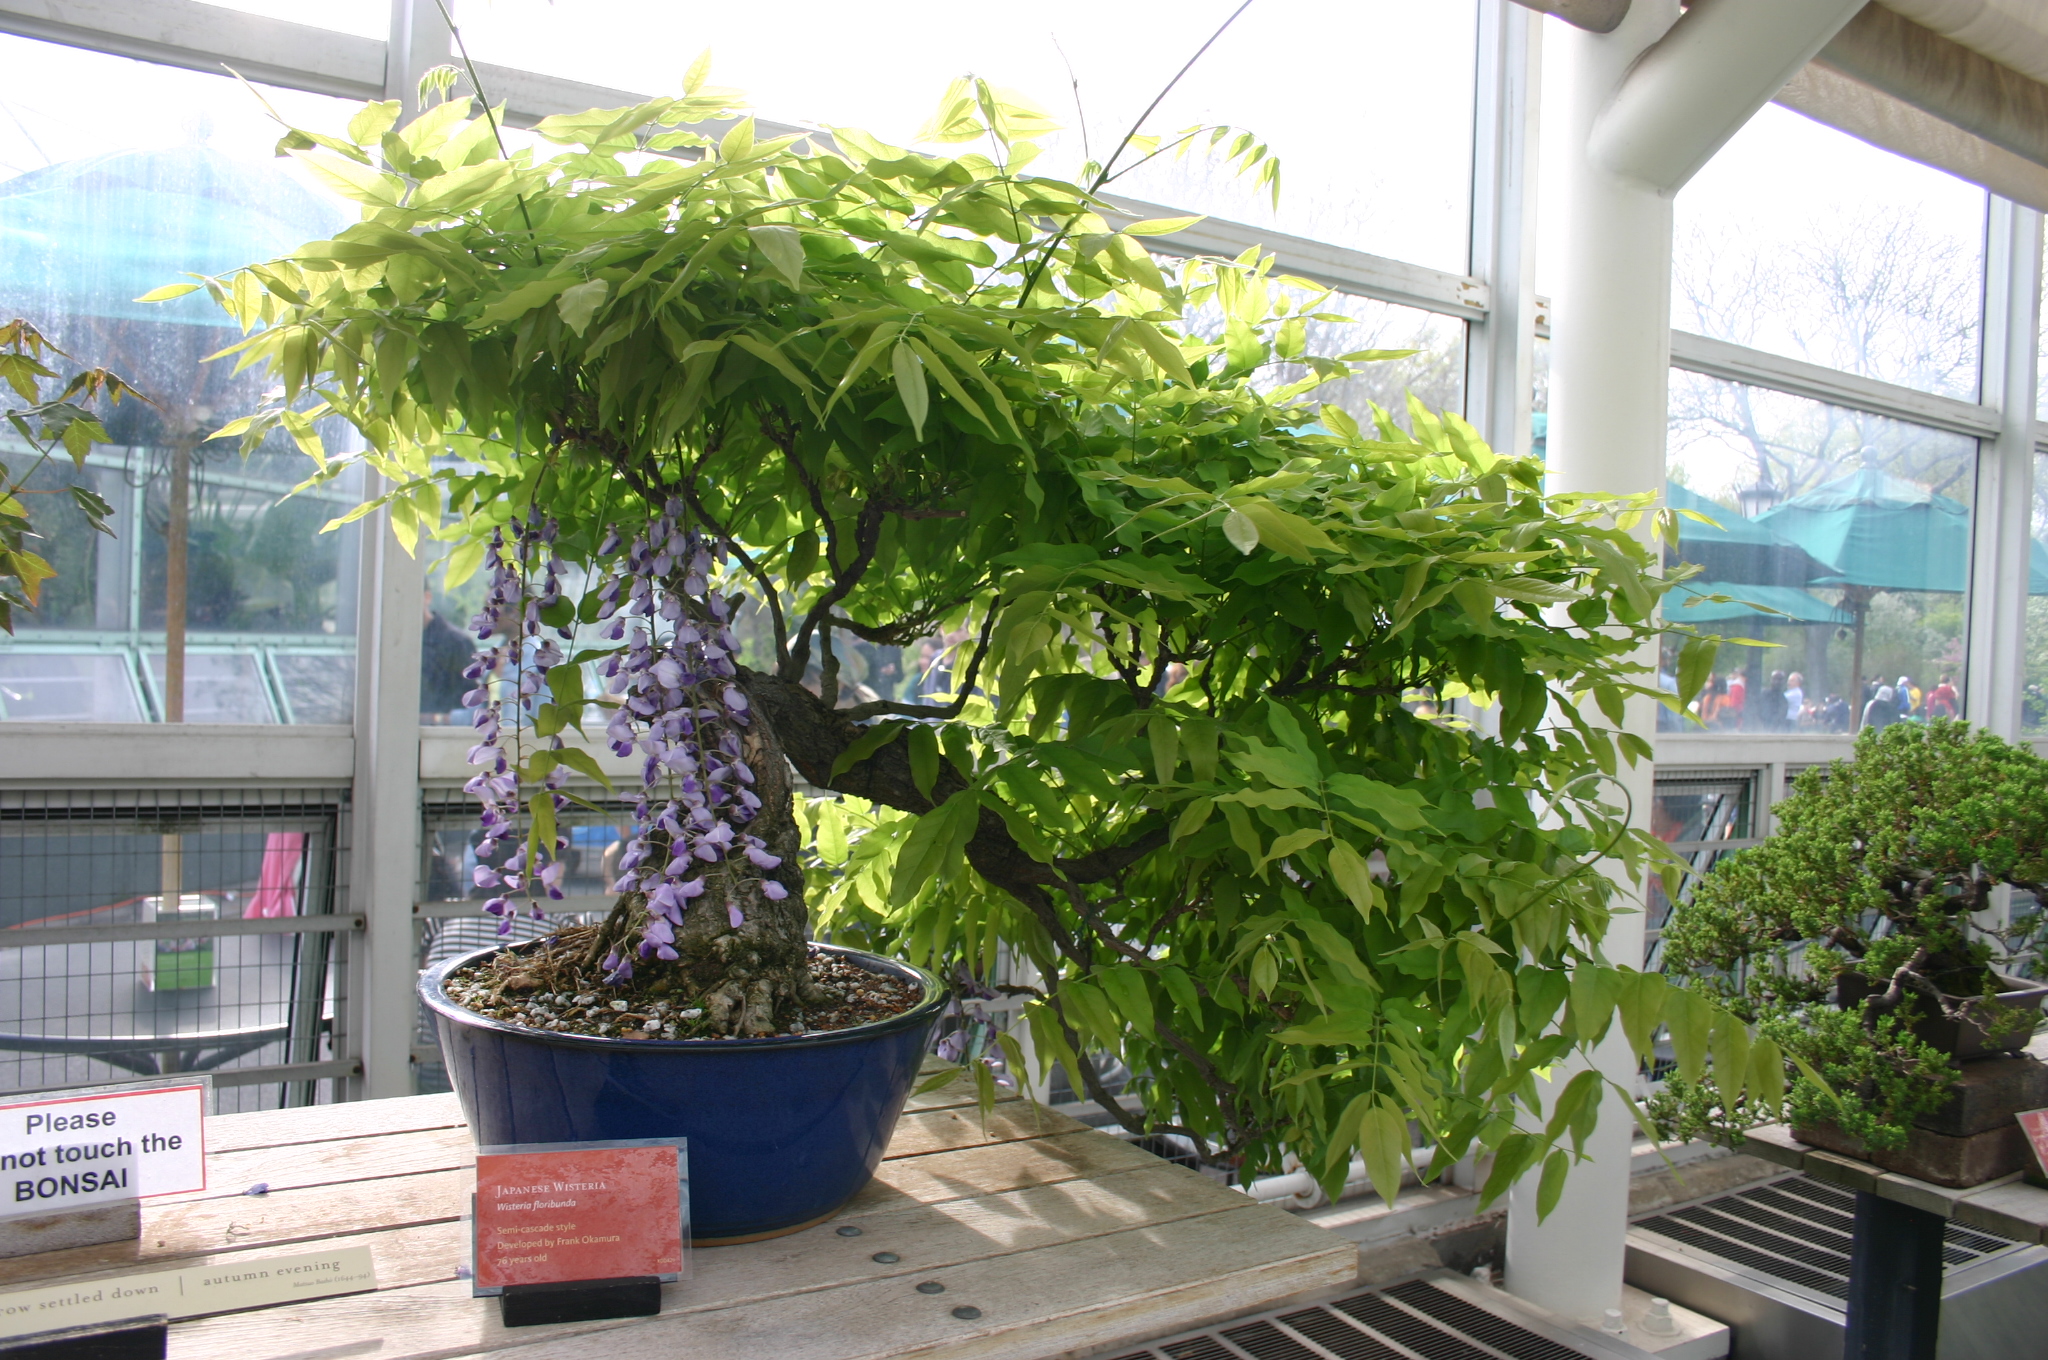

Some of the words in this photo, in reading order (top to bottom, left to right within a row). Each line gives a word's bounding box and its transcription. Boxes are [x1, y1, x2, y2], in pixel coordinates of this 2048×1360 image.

[26, 1110, 117, 1135] Please
[0, 1147, 46, 1171] not
[55, 1136, 133, 1164] touch
[141, 1132, 183, 1153] the
[15, 1167, 128, 1202] BONSAI
[497, 1202, 532, 1211] Wisteria
[532, 1199, 576, 1212] floribunda
[497, 1224, 554, 1235] Semi-cascade
[556, 1222, 576, 1233] style
[497, 1239, 542, 1250] Developed
[545, 1238, 555, 1248] by
[557, 1236, 580, 1246] Frank
[581, 1234, 620, 1244] Okamura
[496, 1256, 508, 1267] 76
[509, 1254, 532, 1266] years
[533, 1253, 548, 1263] old
[39, 1290, 103, 1310] settled
[111, 1286, 159, 1300] down
[203, 1270, 269, 1286] autumn
[276, 1260, 340, 1276] evening
